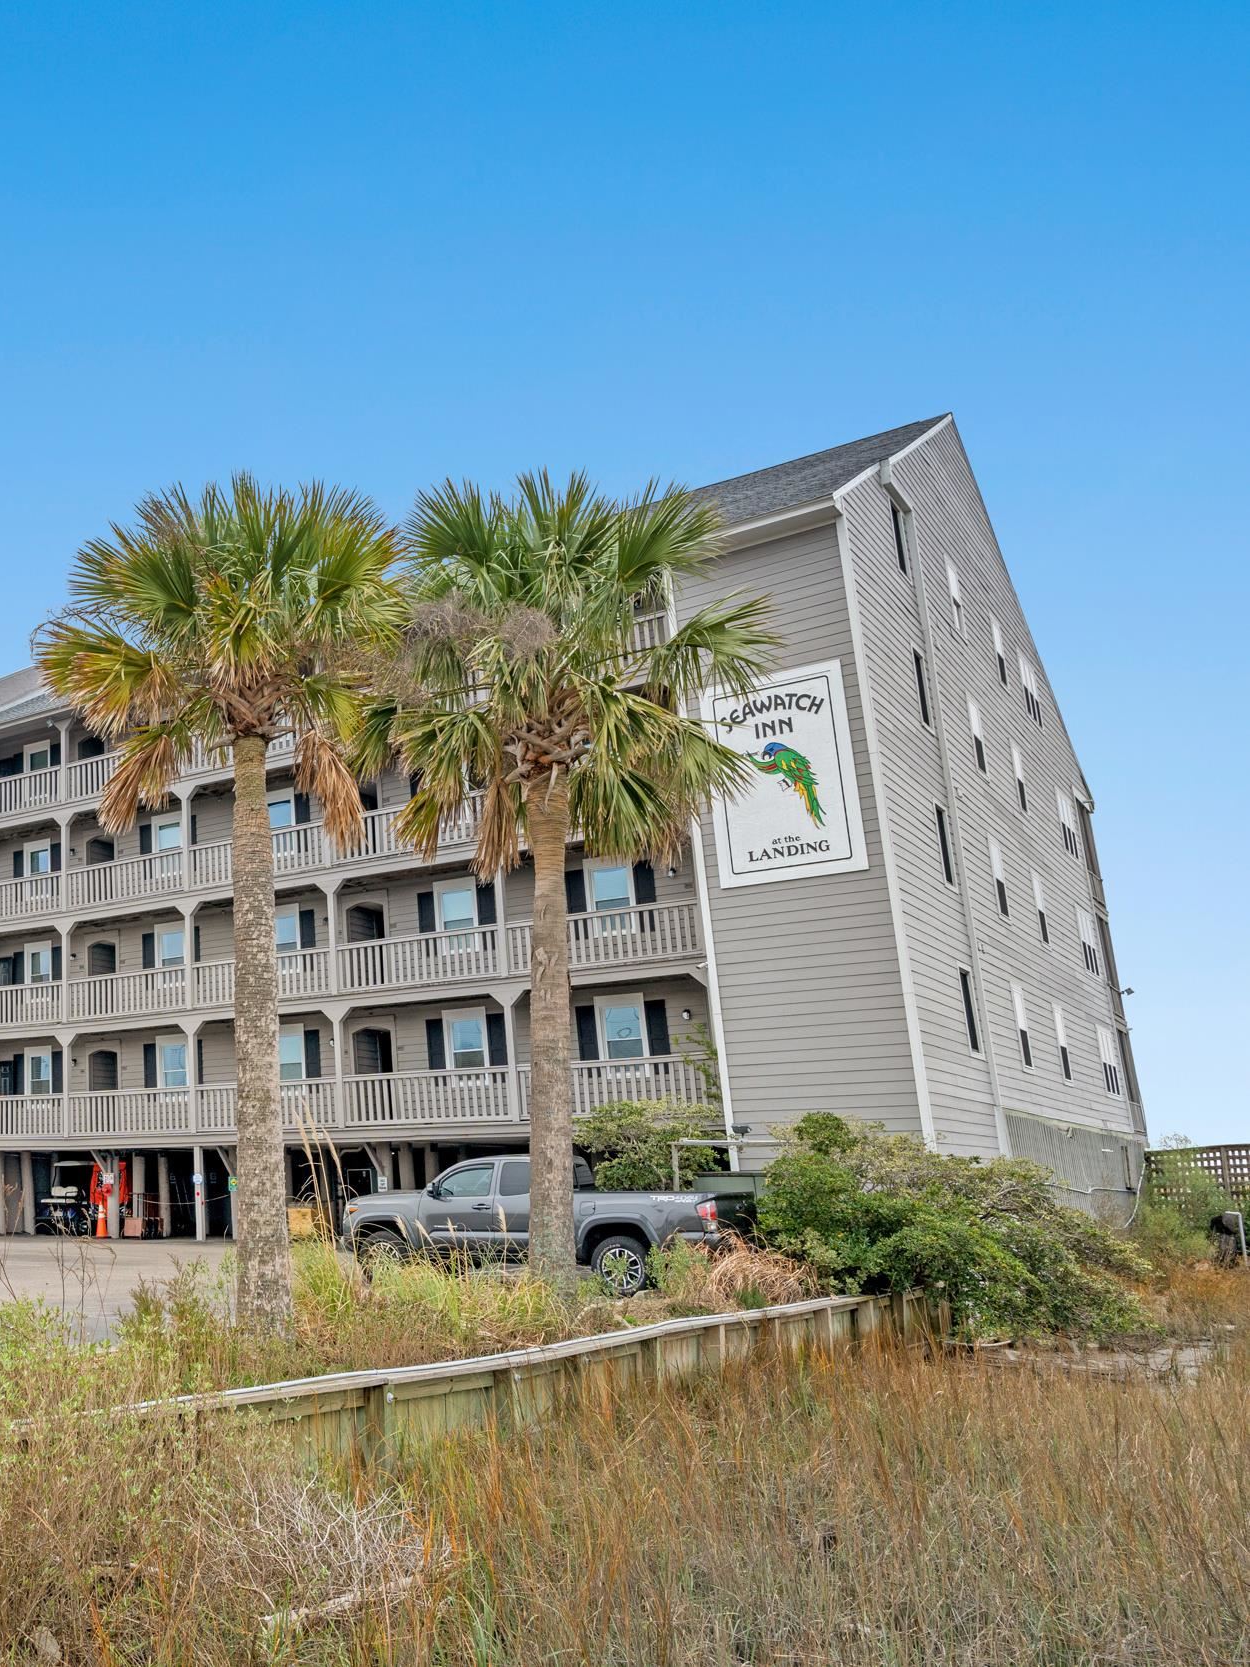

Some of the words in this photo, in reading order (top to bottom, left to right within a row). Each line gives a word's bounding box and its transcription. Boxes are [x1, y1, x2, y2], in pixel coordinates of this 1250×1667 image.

[720, 694, 825, 734] SEAWATCH
[754, 717, 793, 739] INN
[784, 835, 802, 843] the
[747, 839, 831, 862] LANDING
